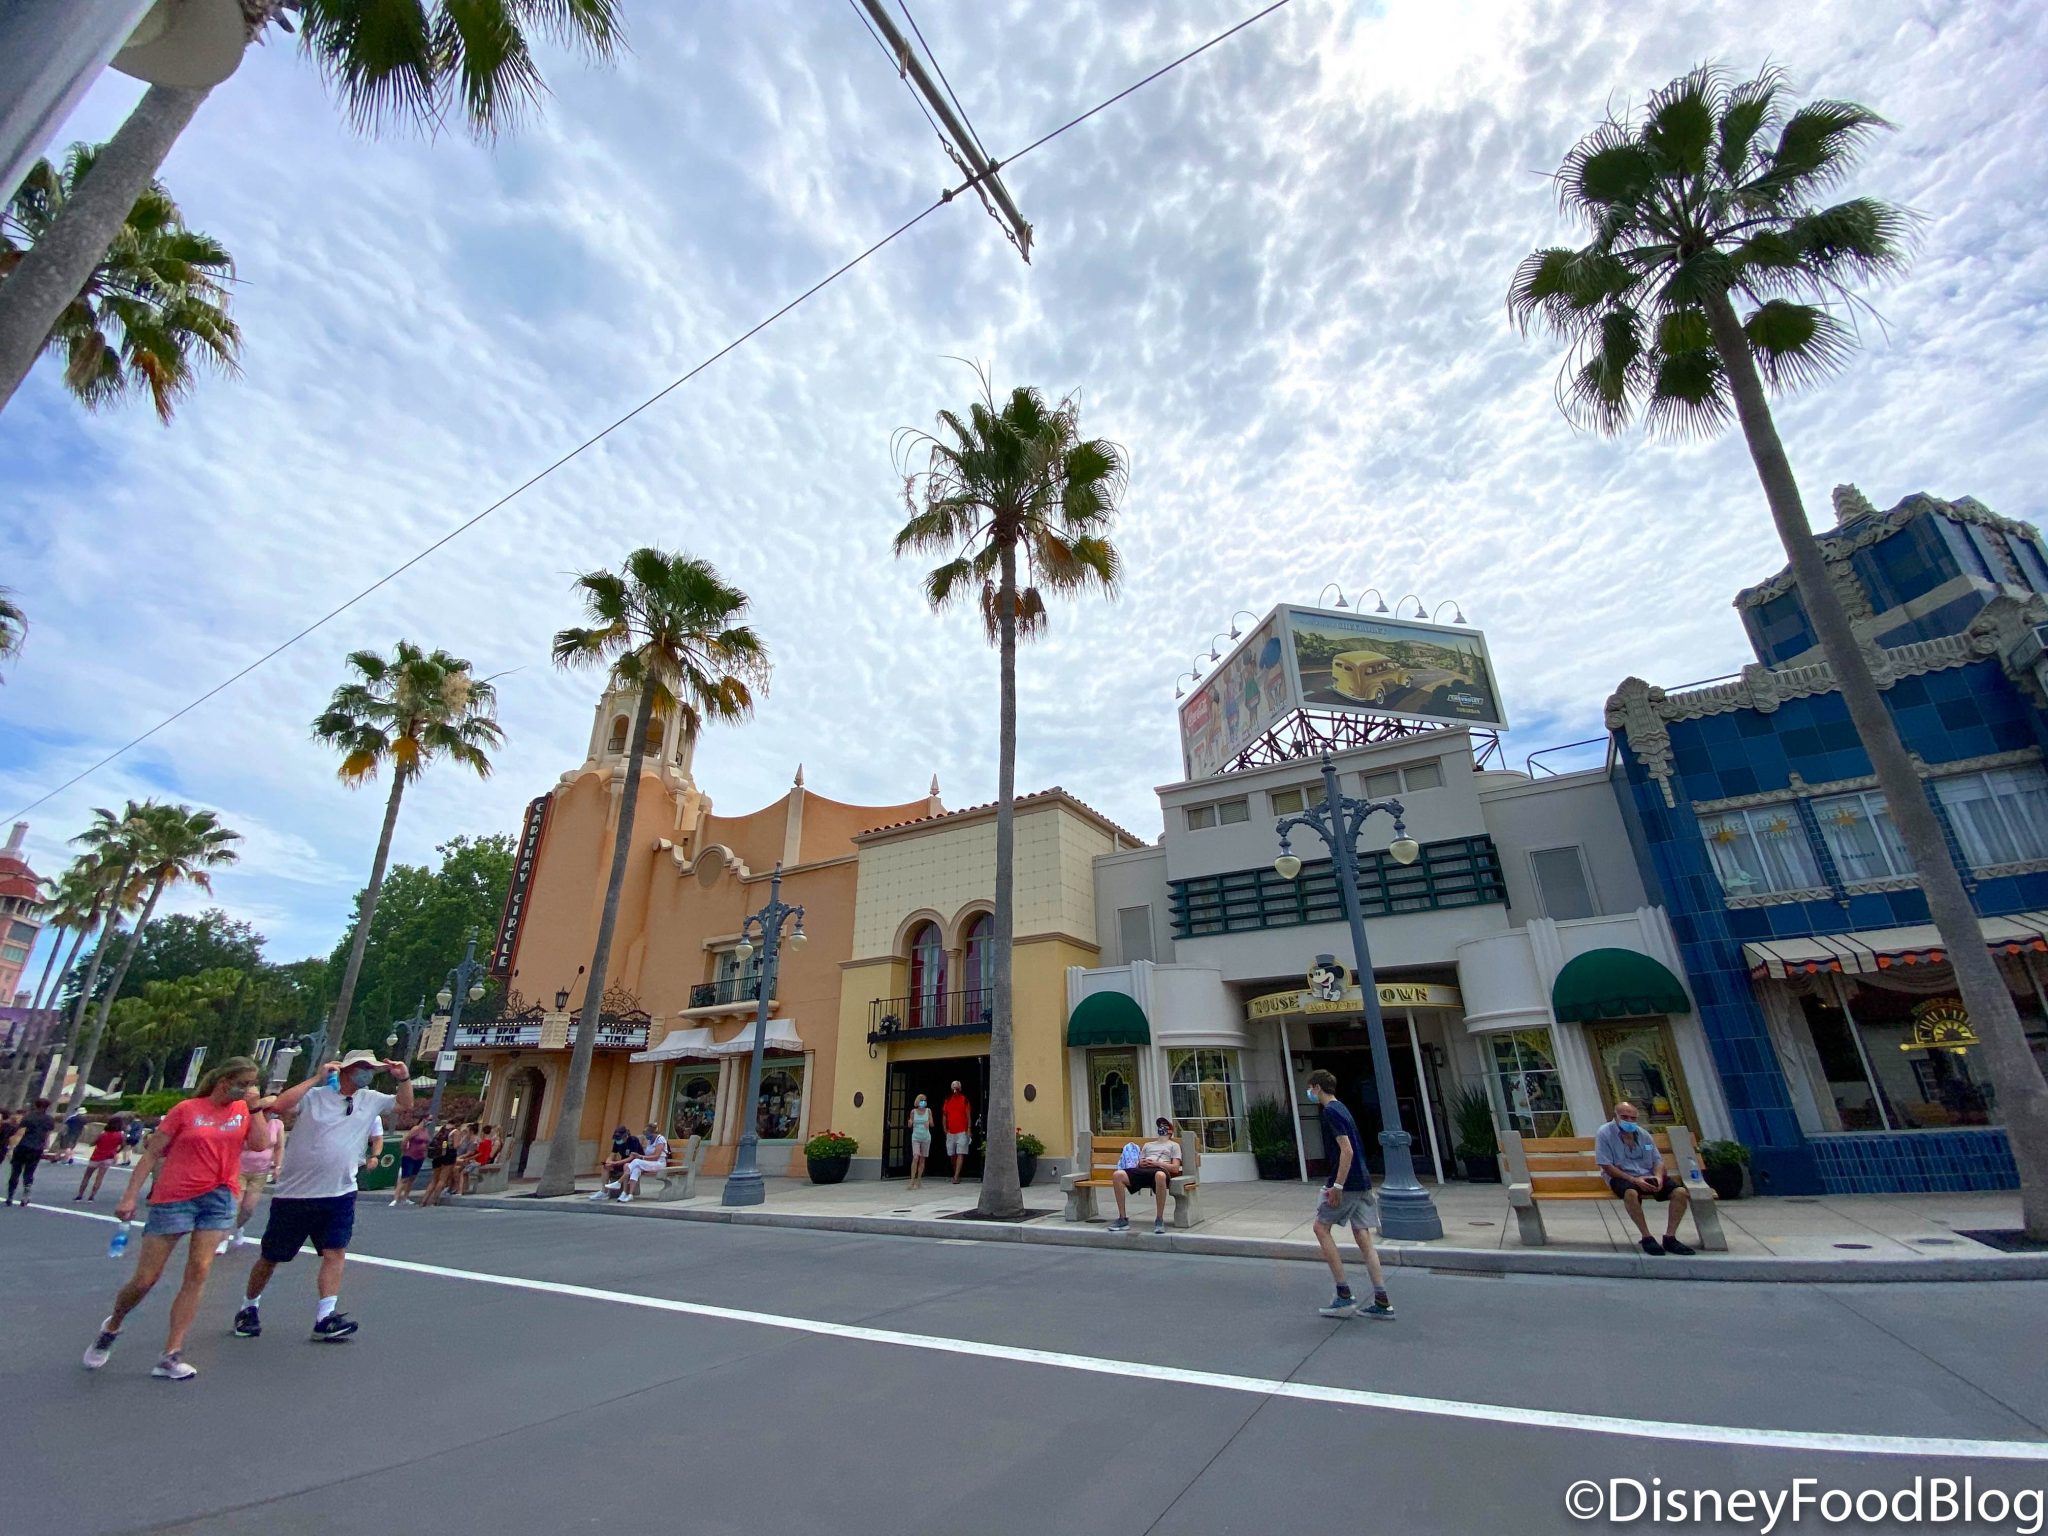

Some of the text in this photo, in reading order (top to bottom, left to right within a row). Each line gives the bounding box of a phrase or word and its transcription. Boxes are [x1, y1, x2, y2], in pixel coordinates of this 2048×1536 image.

[498, 802, 545, 967] CARTHAY CIRCLE
[1380, 988, 1428, 1002] OWN
[466, 1027, 521, 1035] ONCE UPON
[609, 1027, 634, 1036] UPON
[495, 1035, 516, 1043] TIME
[604, 1035, 628, 1043] TIME
